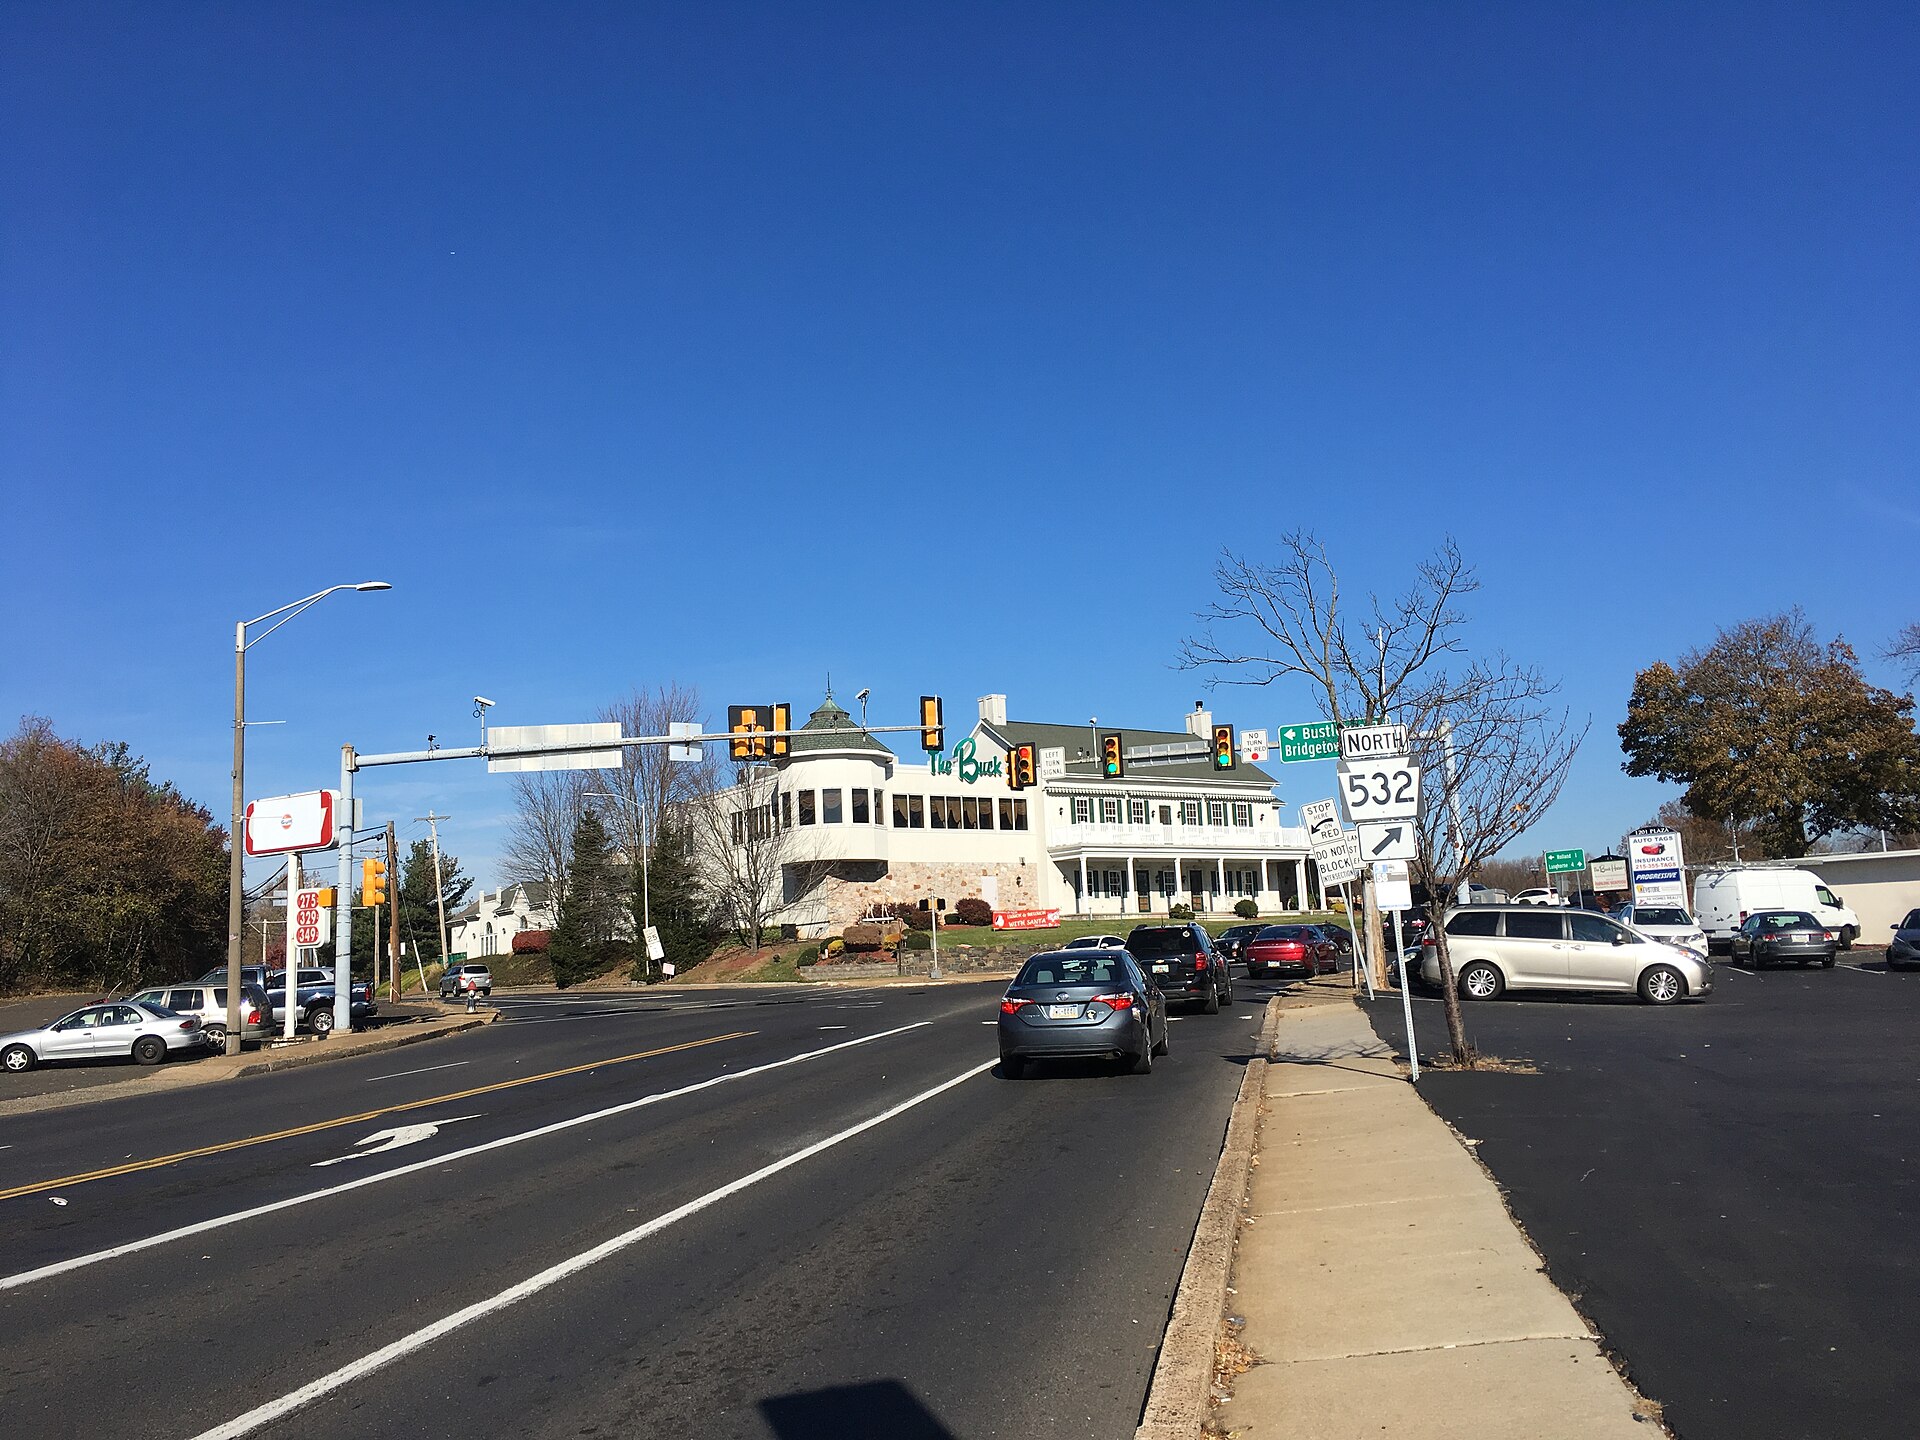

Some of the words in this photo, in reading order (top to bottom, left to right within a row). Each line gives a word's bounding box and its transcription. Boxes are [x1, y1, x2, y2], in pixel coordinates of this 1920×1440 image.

[1348, 732, 1403, 752] NORTH
[927, 749, 953, 776] The
[952, 737, 1003, 784] Buck
[1045, 751, 1059, 759] LEFT
[1043, 768, 1064, 776] SIGNAL
[1349, 770, 1415, 808] 532
[1306, 802, 1332, 816] STOP
[1313, 811, 1329, 821] HERE
[1324, 822, 1334, 830] ON
[1320, 828, 1340, 840] RED
[1316, 848, 1328, 861] DO
[1330, 844, 1347, 858] NOT
[1634, 855, 1676, 864] INSURANCE
[1319, 857, 1351, 874] BLOCK
[1635, 861, 1677, 870] 215-355-TAGS
[1323, 869, 1356, 883] INTERSECTION
[1635, 871, 1678, 881] PROGRESSIVE
[299, 893, 317, 909] 275
[299, 910, 317, 925] 329
[299, 927, 317, 943] 349
[647, 934, 657, 942] 25
